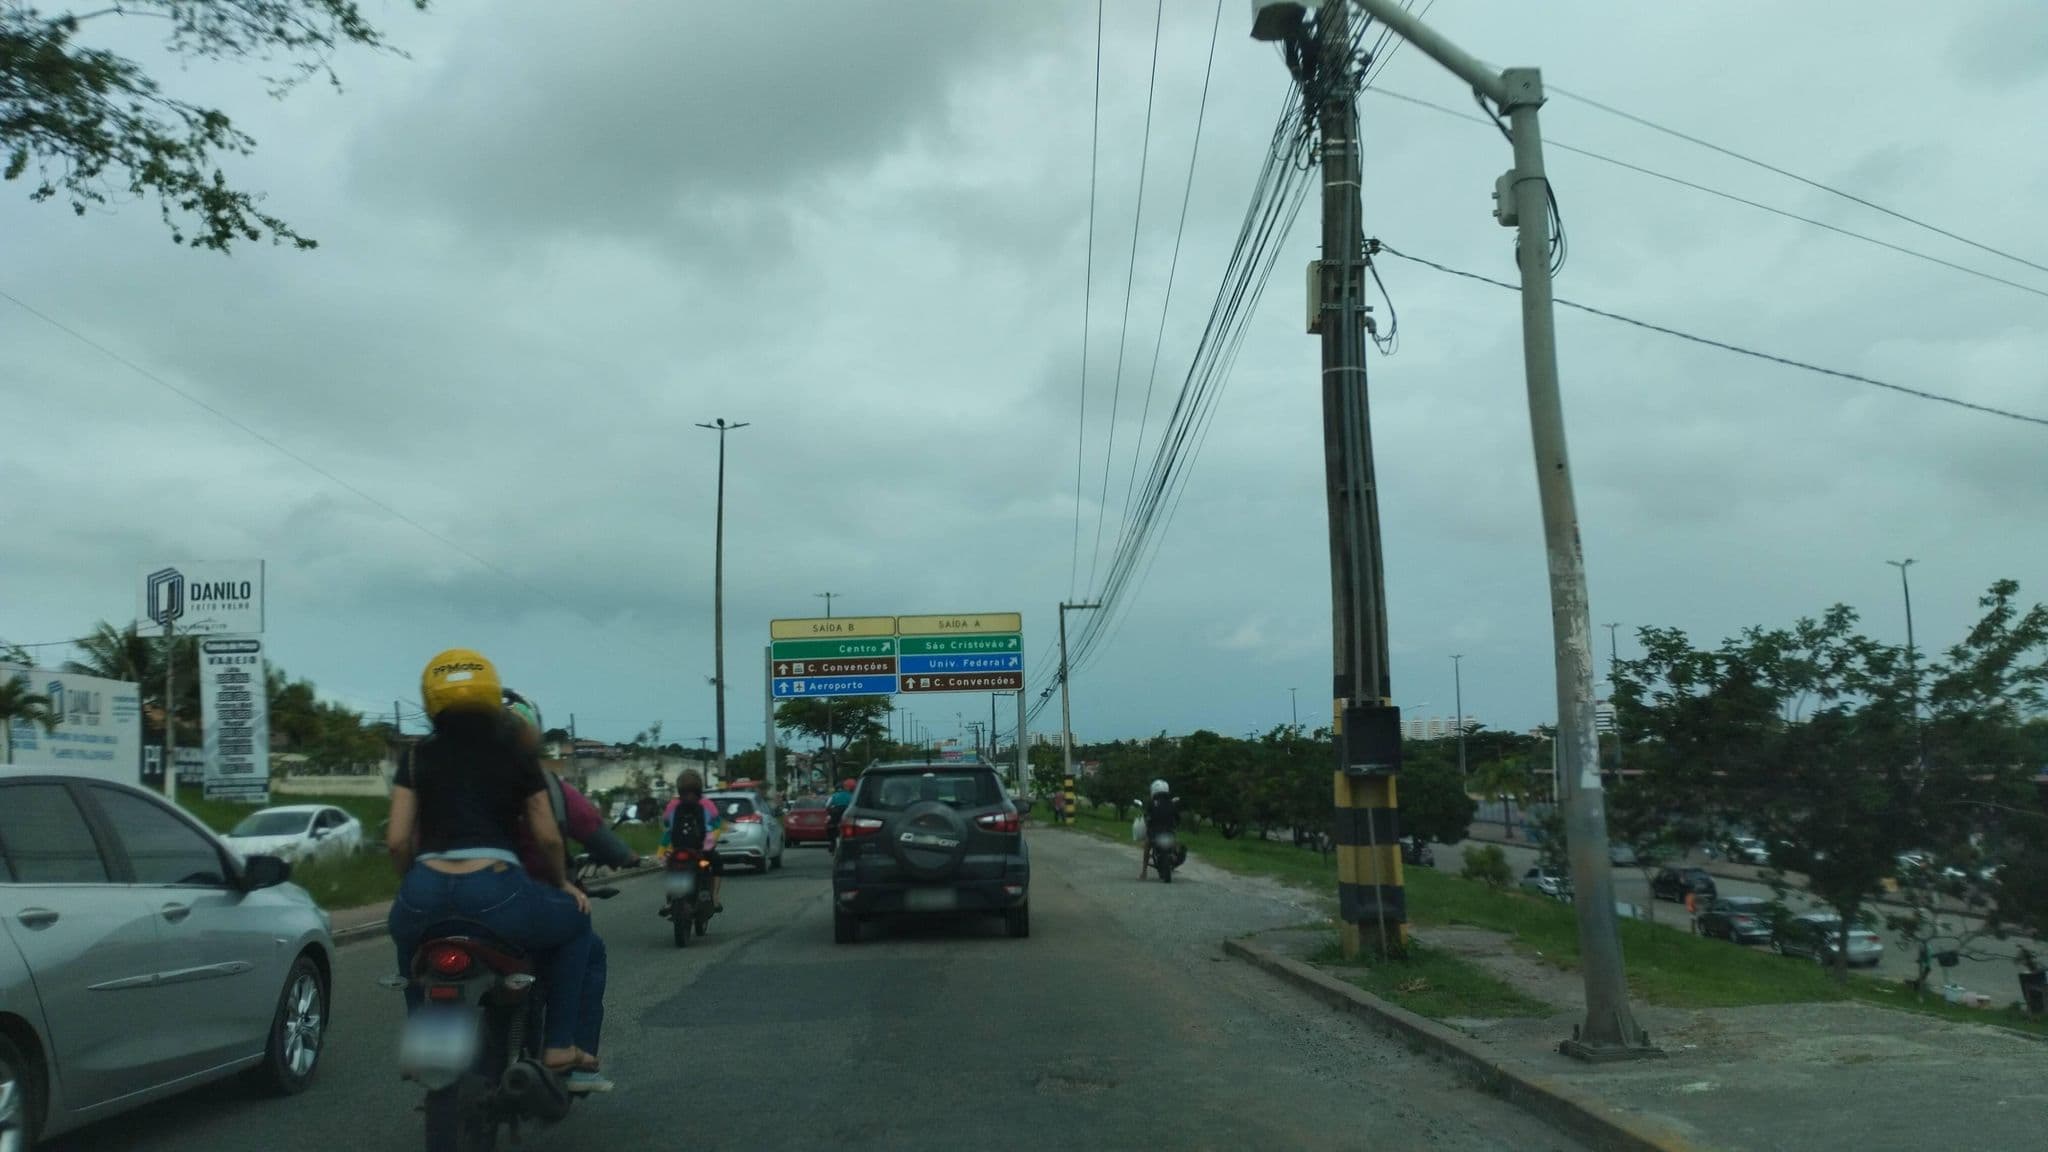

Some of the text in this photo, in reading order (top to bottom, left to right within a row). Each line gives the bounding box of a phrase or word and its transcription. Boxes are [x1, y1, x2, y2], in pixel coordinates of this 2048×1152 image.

[191, 581, 251, 601] DANILO
[812, 622, 855, 633] SAÍDA B
[939, 618, 981, 629] SAÍDA A
[839, 645, 877, 653] Centro
[963, 657, 1005, 667] Federal
[809, 682, 864, 691] Aeroporto
[934, 678, 944, 687] C.
